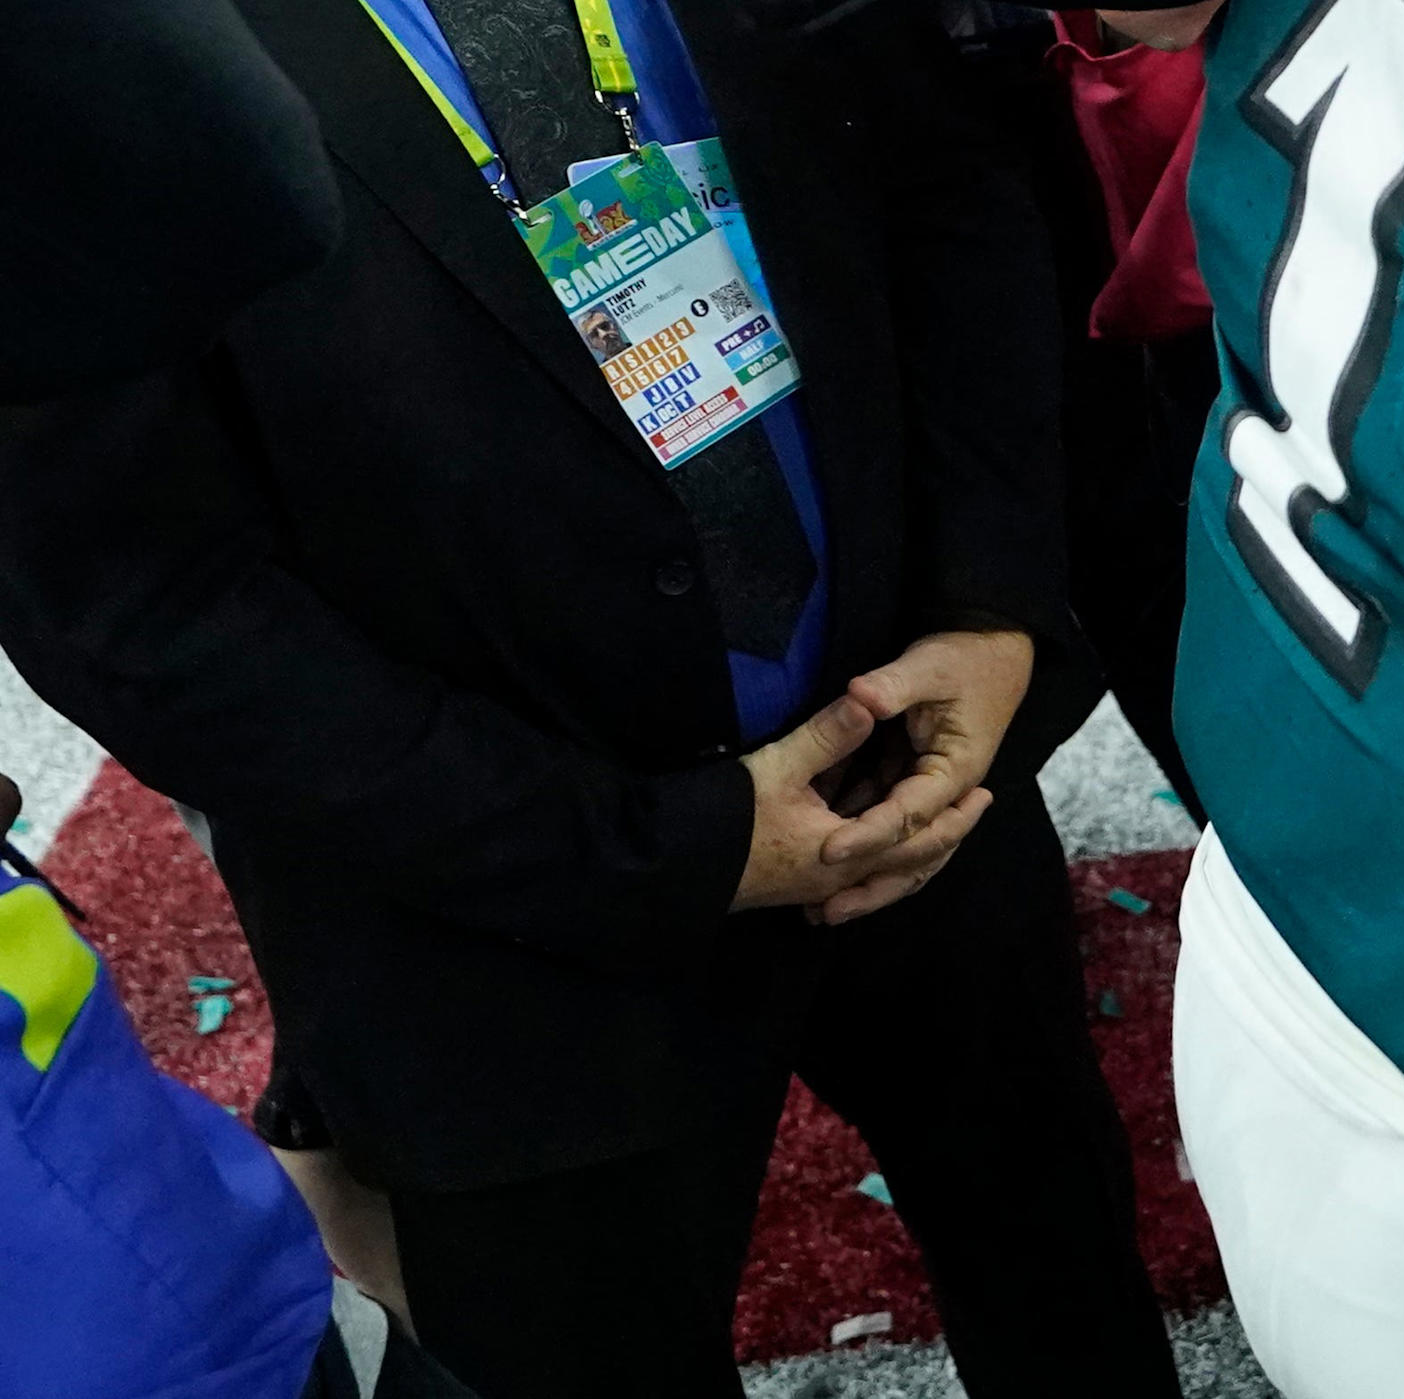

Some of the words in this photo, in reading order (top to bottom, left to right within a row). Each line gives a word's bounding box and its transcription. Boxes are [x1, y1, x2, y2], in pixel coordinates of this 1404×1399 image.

[553, 206, 697, 309] GAMEDAY
[605, 278, 648, 306] TIMOTHY
[611, 298, 637, 317] LUTZ
[720, 333, 743, 352] PRE
